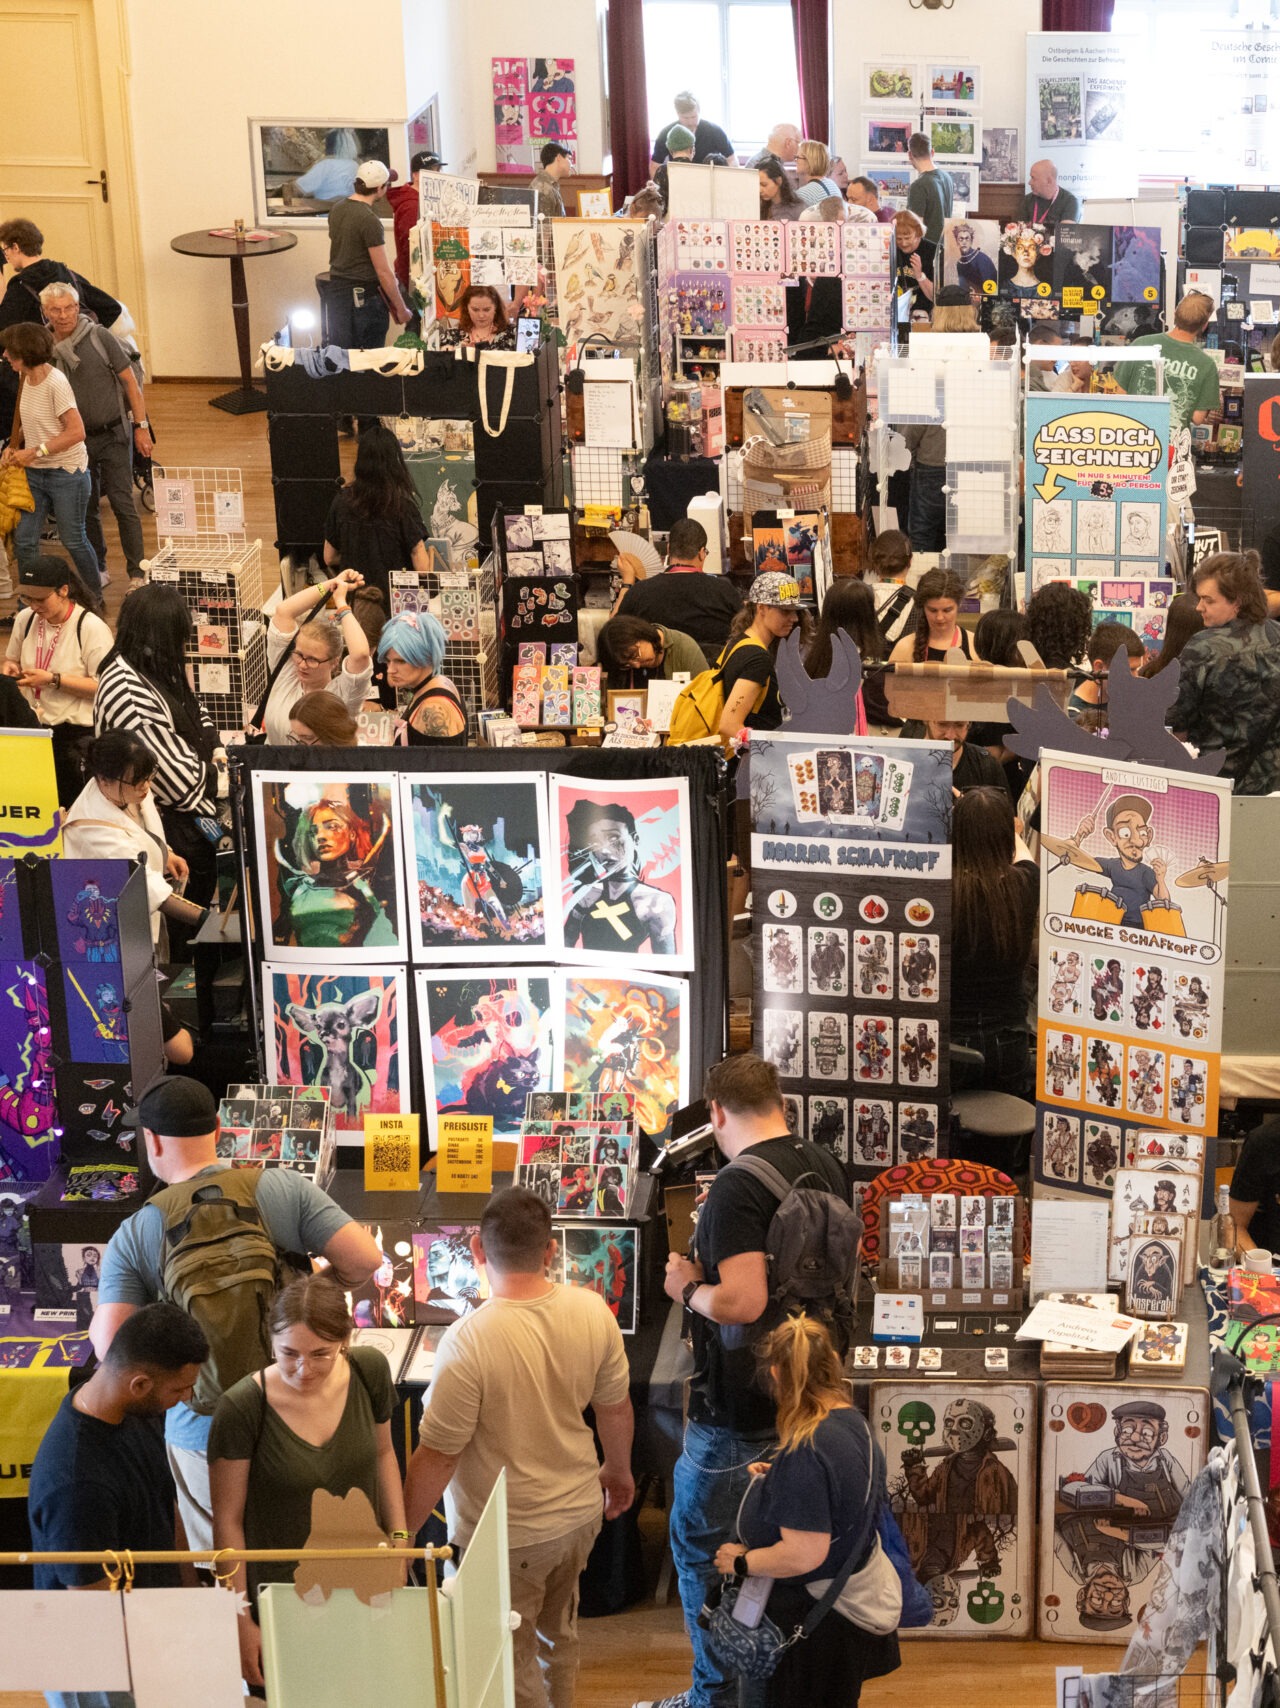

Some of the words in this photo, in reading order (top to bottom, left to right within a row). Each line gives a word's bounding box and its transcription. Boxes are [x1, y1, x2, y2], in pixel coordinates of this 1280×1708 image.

[987, 283, 993, 291] 2
[1148, 290, 1154, 298] 5
[1040, 425, 1096, 444] LASS
[1099, 427, 1157, 446] DICH
[1035, 448, 1159, 469] ZEICHNEN!
[1105, 771, 1127, 784] ANDI'S
[1132, 774, 1166, 791] LUSTIGES
[762, 840, 832, 866] HORROR
[837, 846, 940, 872] SCHAFKOPF
[1064, 922, 1114, 940] MUCKE
[1119, 930, 1198, 956] SCHAFKOPF
[380, 1120, 403, 1129] INSTA
[444, 1122, 488, 1131] PREISLISTE
